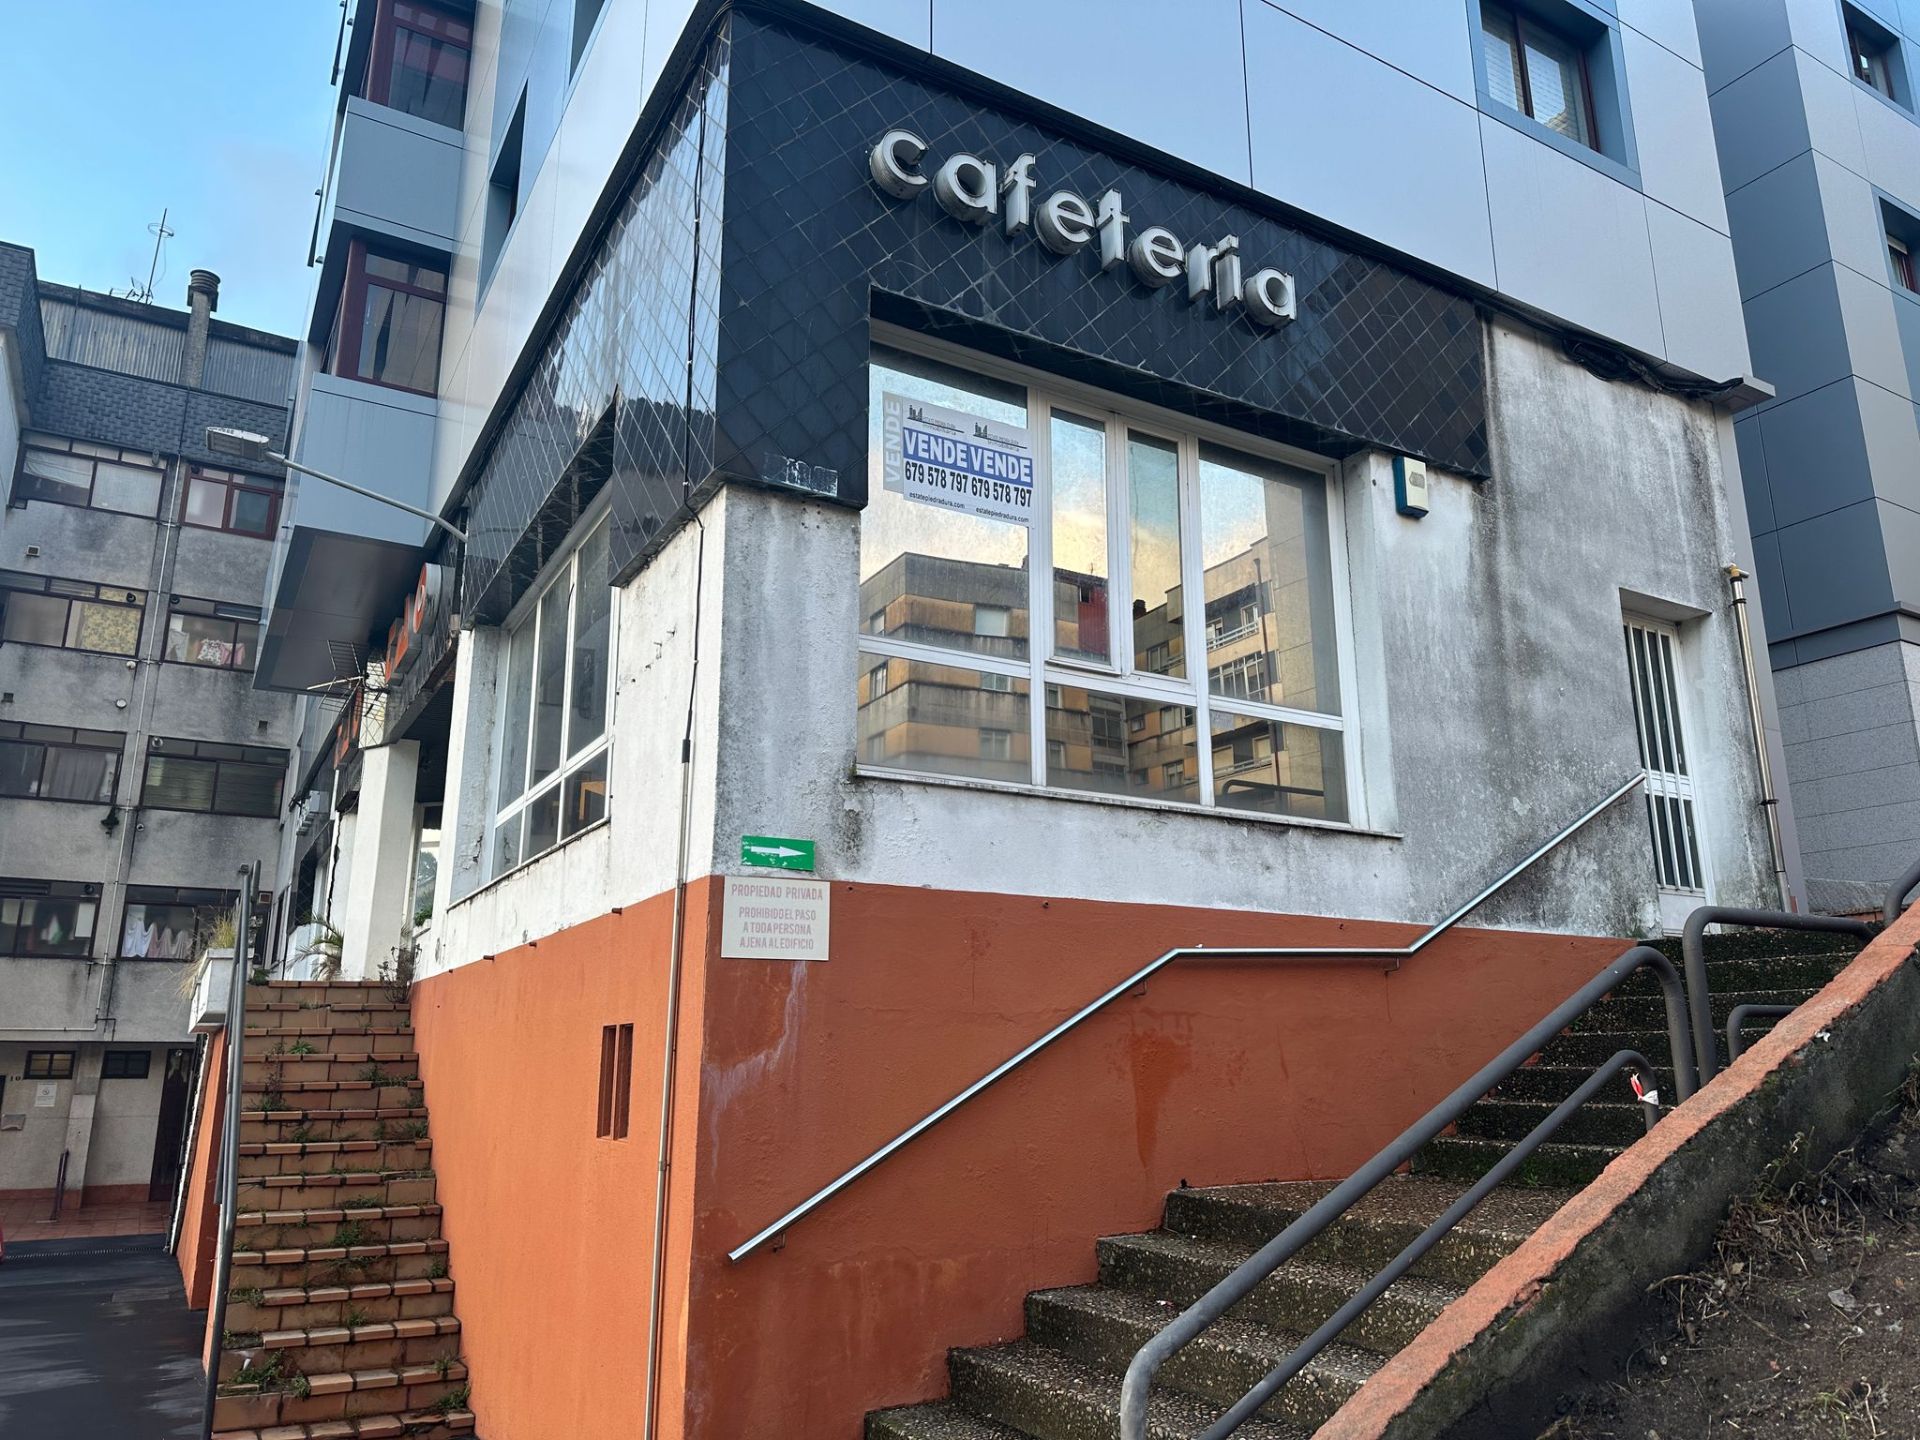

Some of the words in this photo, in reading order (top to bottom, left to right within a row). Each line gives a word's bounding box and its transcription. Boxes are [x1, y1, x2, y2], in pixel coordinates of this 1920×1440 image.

[885, 399, 900, 482] VENDE
[904, 429, 968, 468] VENDE
[970, 446, 1031, 483] VENDE
[905, 460, 924, 483] 679
[928, 466, 946, 488] 578
[950, 471, 968, 493] 797
[909, 492, 965, 509] estatepiedradura.com
[971, 477, 990, 499] 679
[993, 482, 1011, 503] 578
[1014, 487, 1032, 507] 797
[976, 507, 1029, 522] estatepiedradura.com
[731, 883, 782, 898] PROPIEDAD
[785, 887, 823, 901] PRIVADA
[739, 906, 784, 920] PROHIBIDO
[795, 909, 817, 921] PASO
[743, 921, 749, 934] A
[750, 922, 773, 934] TODA
[773, 923, 812, 936] PERSONA
[740, 936, 767, 949] AJENA
[768, 938, 780, 949] AL
[780, 938, 814, 950] EDIFICIO
